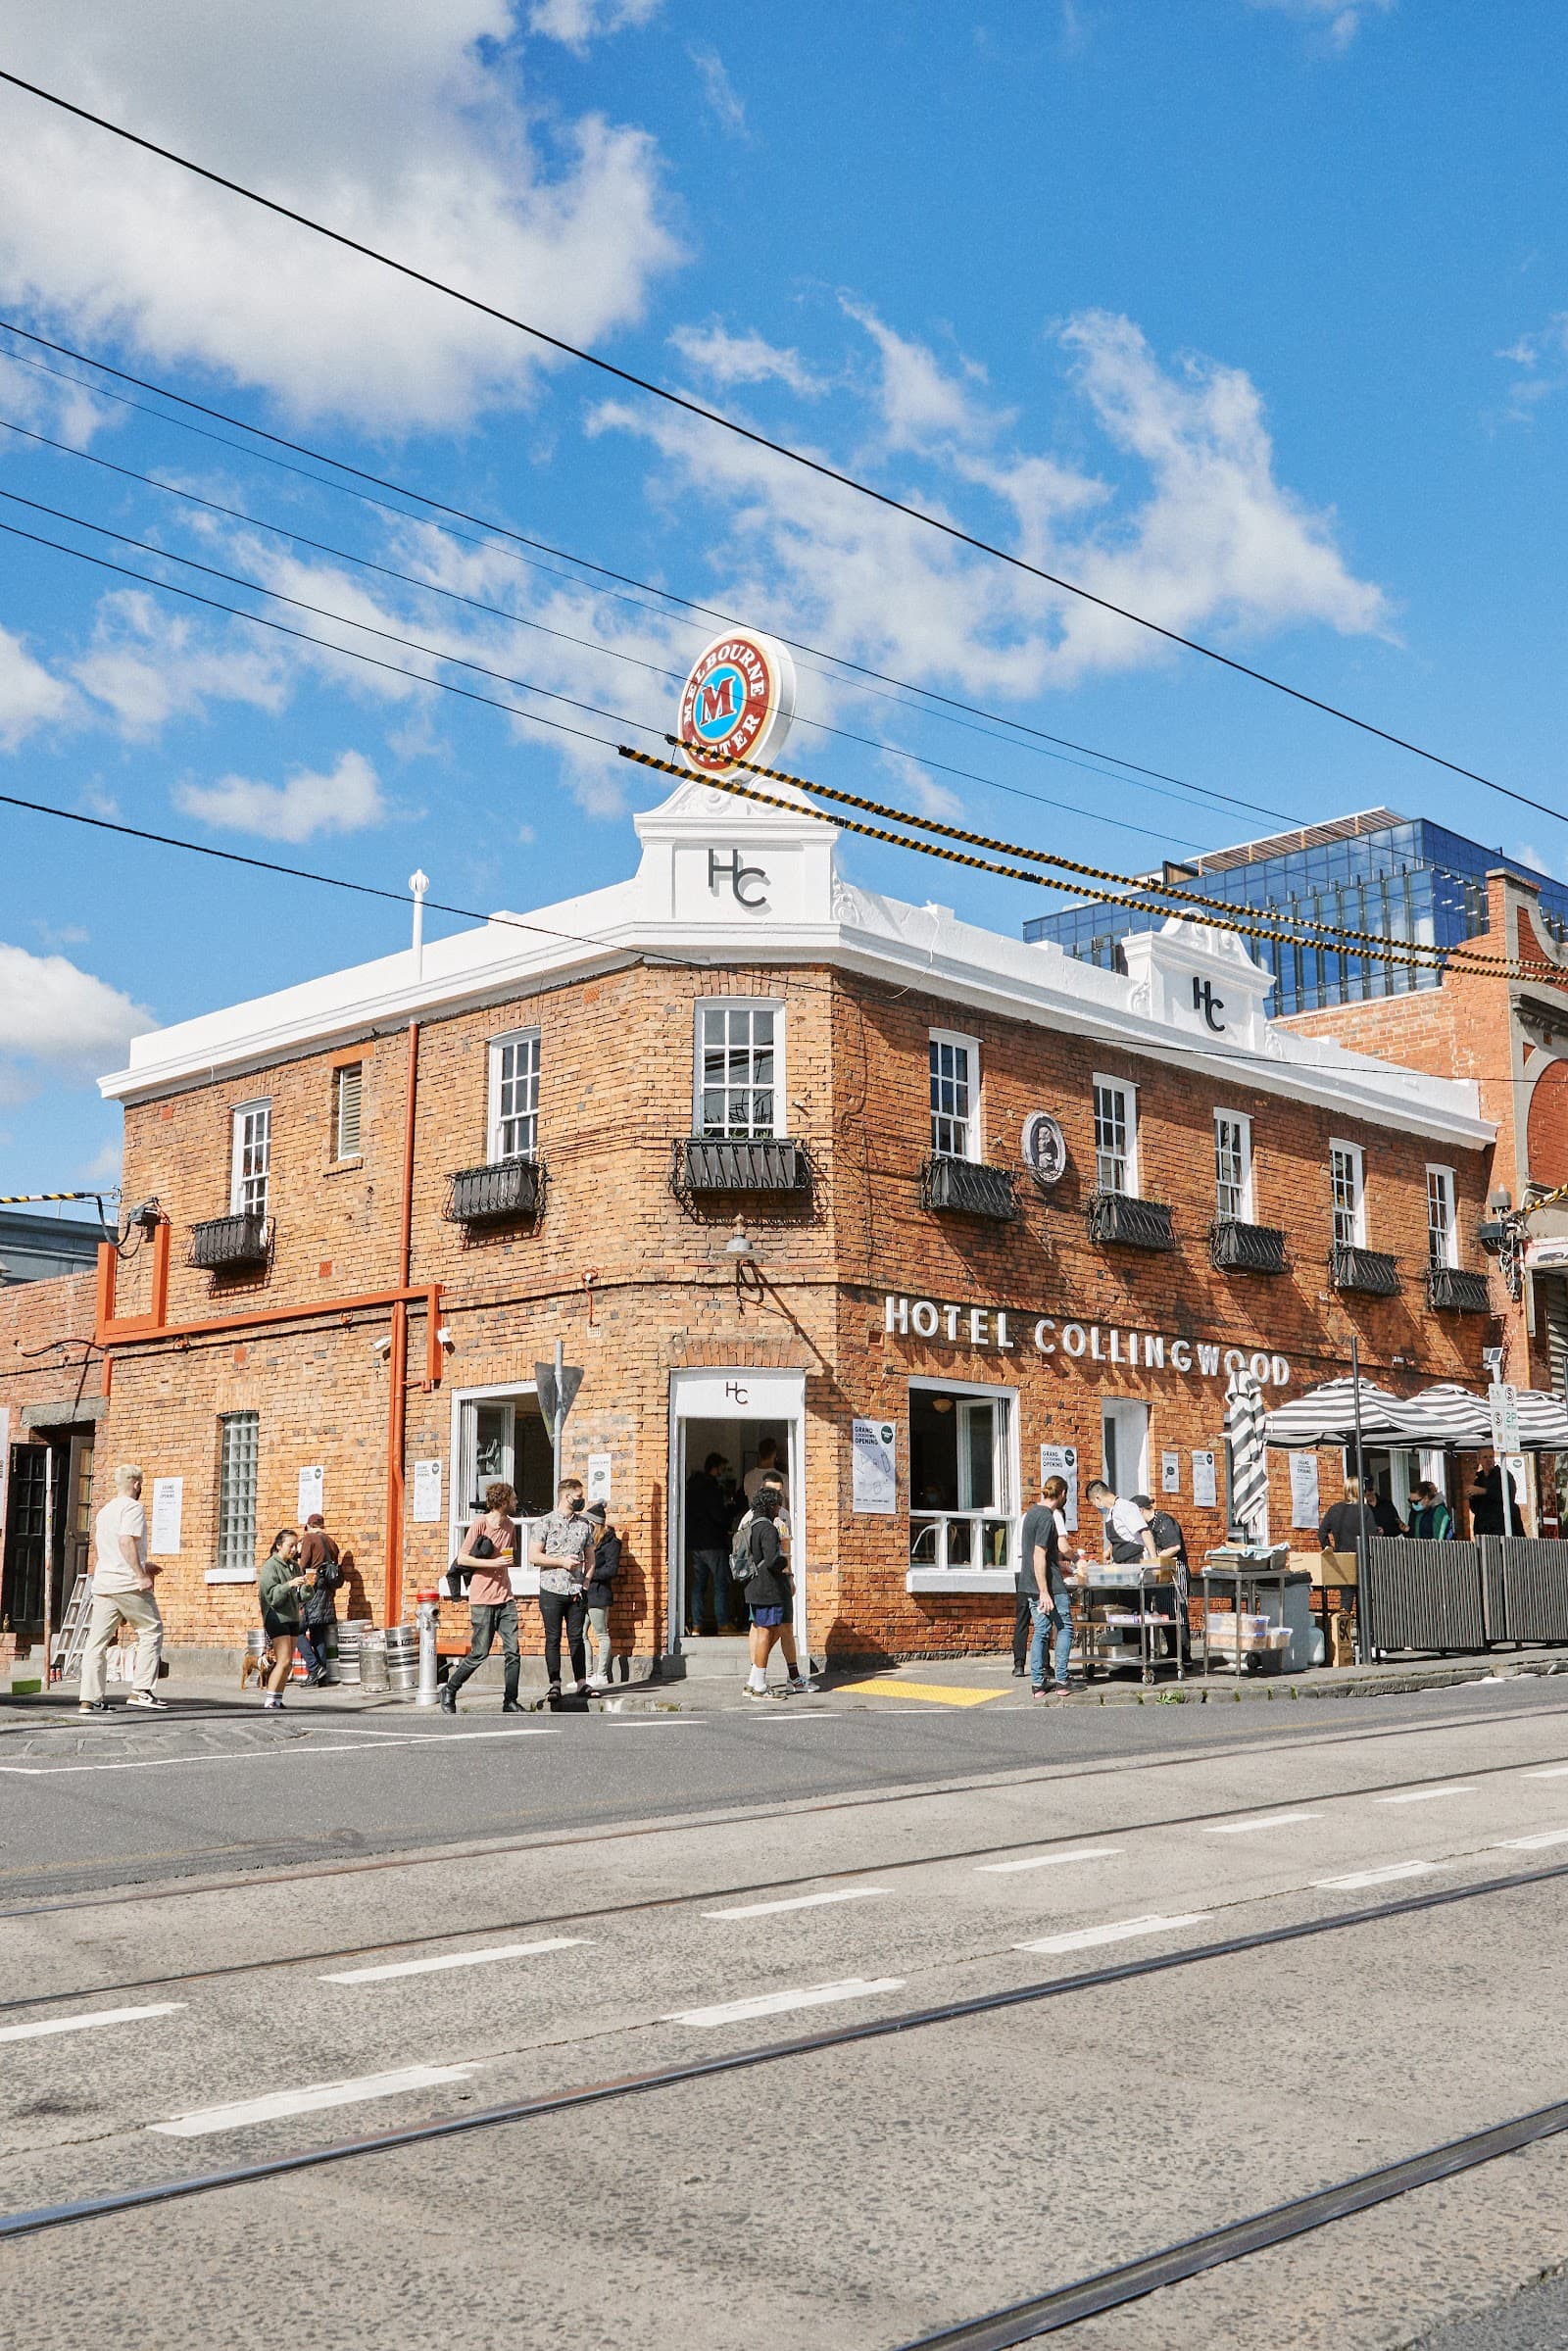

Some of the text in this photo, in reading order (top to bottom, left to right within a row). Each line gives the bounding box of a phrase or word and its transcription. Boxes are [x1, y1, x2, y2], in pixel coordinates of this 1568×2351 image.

[684, 645, 764, 725] MELBOURNE
[700, 676, 736, 726] M
[709, 848, 767, 906] HC
[1193, 976, 1225, 1032] HC
[886, 1297, 1290, 1386] HOTEL COLLINGWOOD
[725, 1382, 749, 1404] HC
